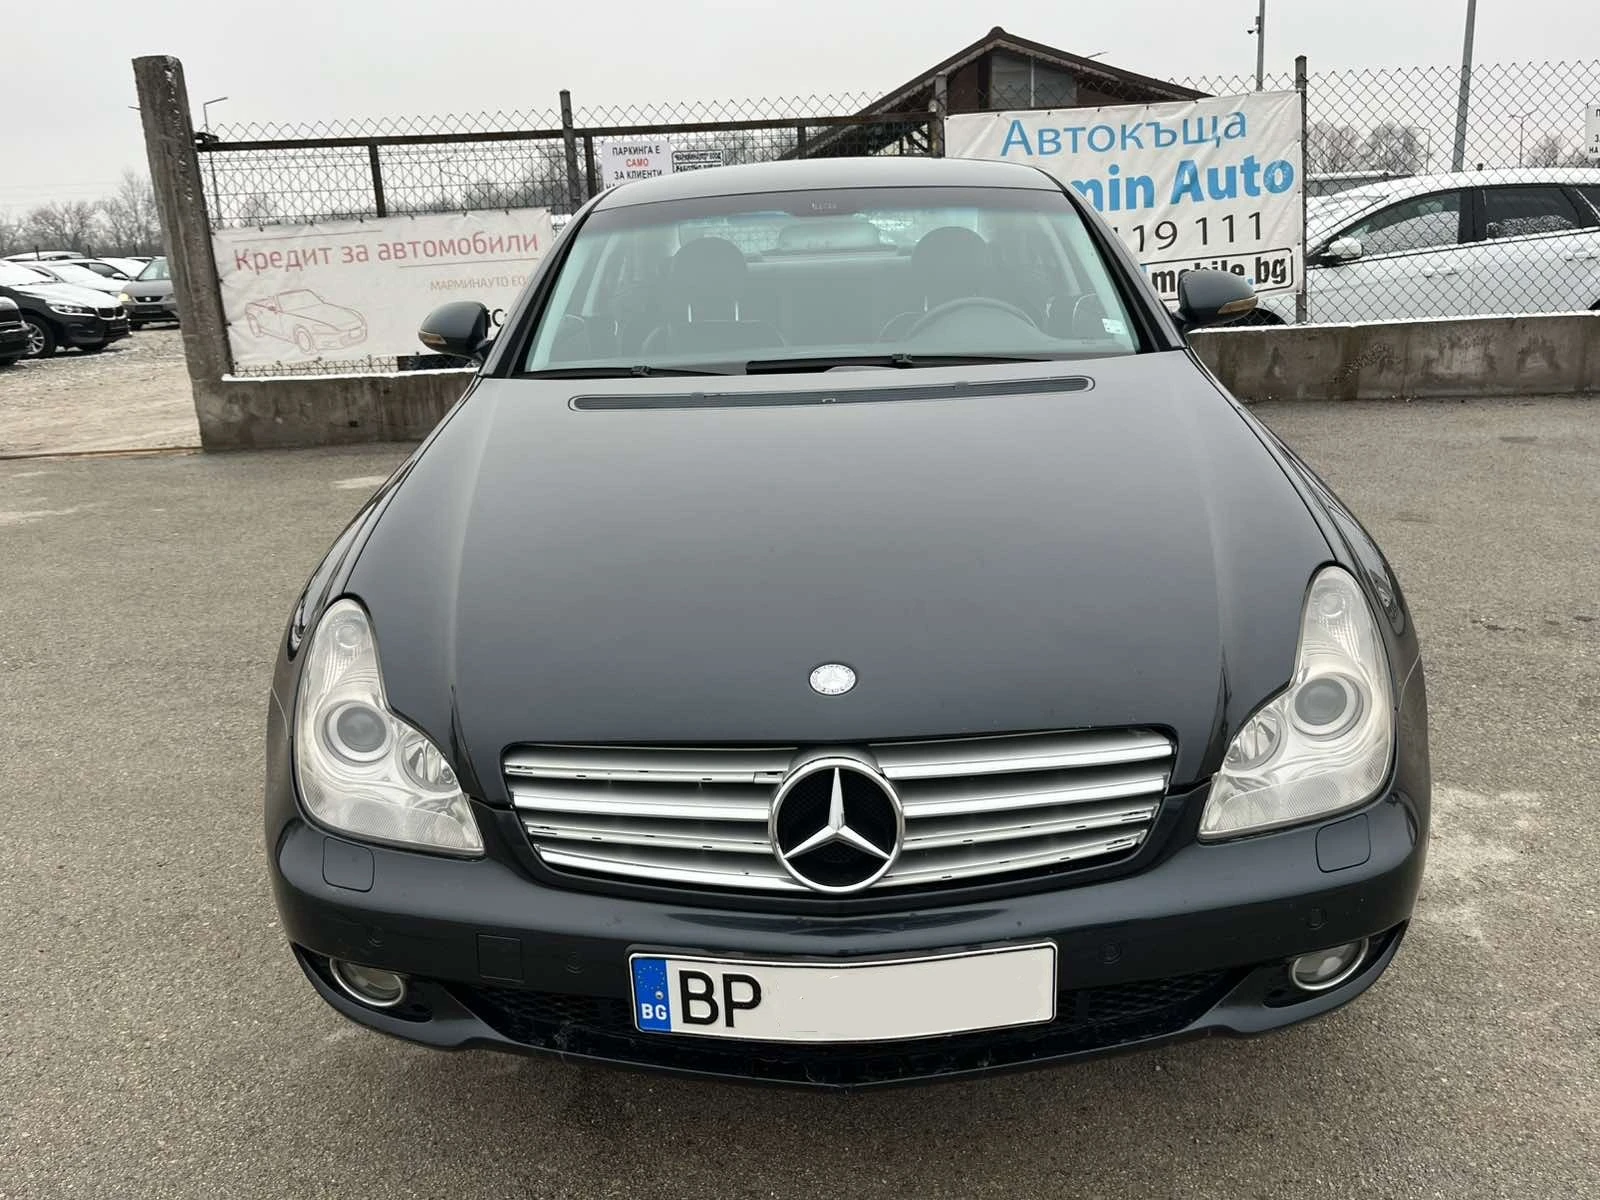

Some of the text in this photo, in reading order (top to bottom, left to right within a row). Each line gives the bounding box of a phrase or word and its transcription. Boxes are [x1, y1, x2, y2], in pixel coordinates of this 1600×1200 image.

[1000, 111, 1247, 157] Автокъща
[612, 145, 661, 156] ПАРКИНГА Е
[626, 158, 649, 168] САМО
[614, 169, 662, 180] ЗА КЛИЕНТИ
[1170, 155, 1295, 205] Auto
[1112, 211, 1262, 253] 19 111
[234, 231, 538, 276] Кредит за автомобили
[511, 275, 528, 288] ЕО
[1151, 256, 1287, 293] me.bg
[641, 1003, 668, 1021] BG
